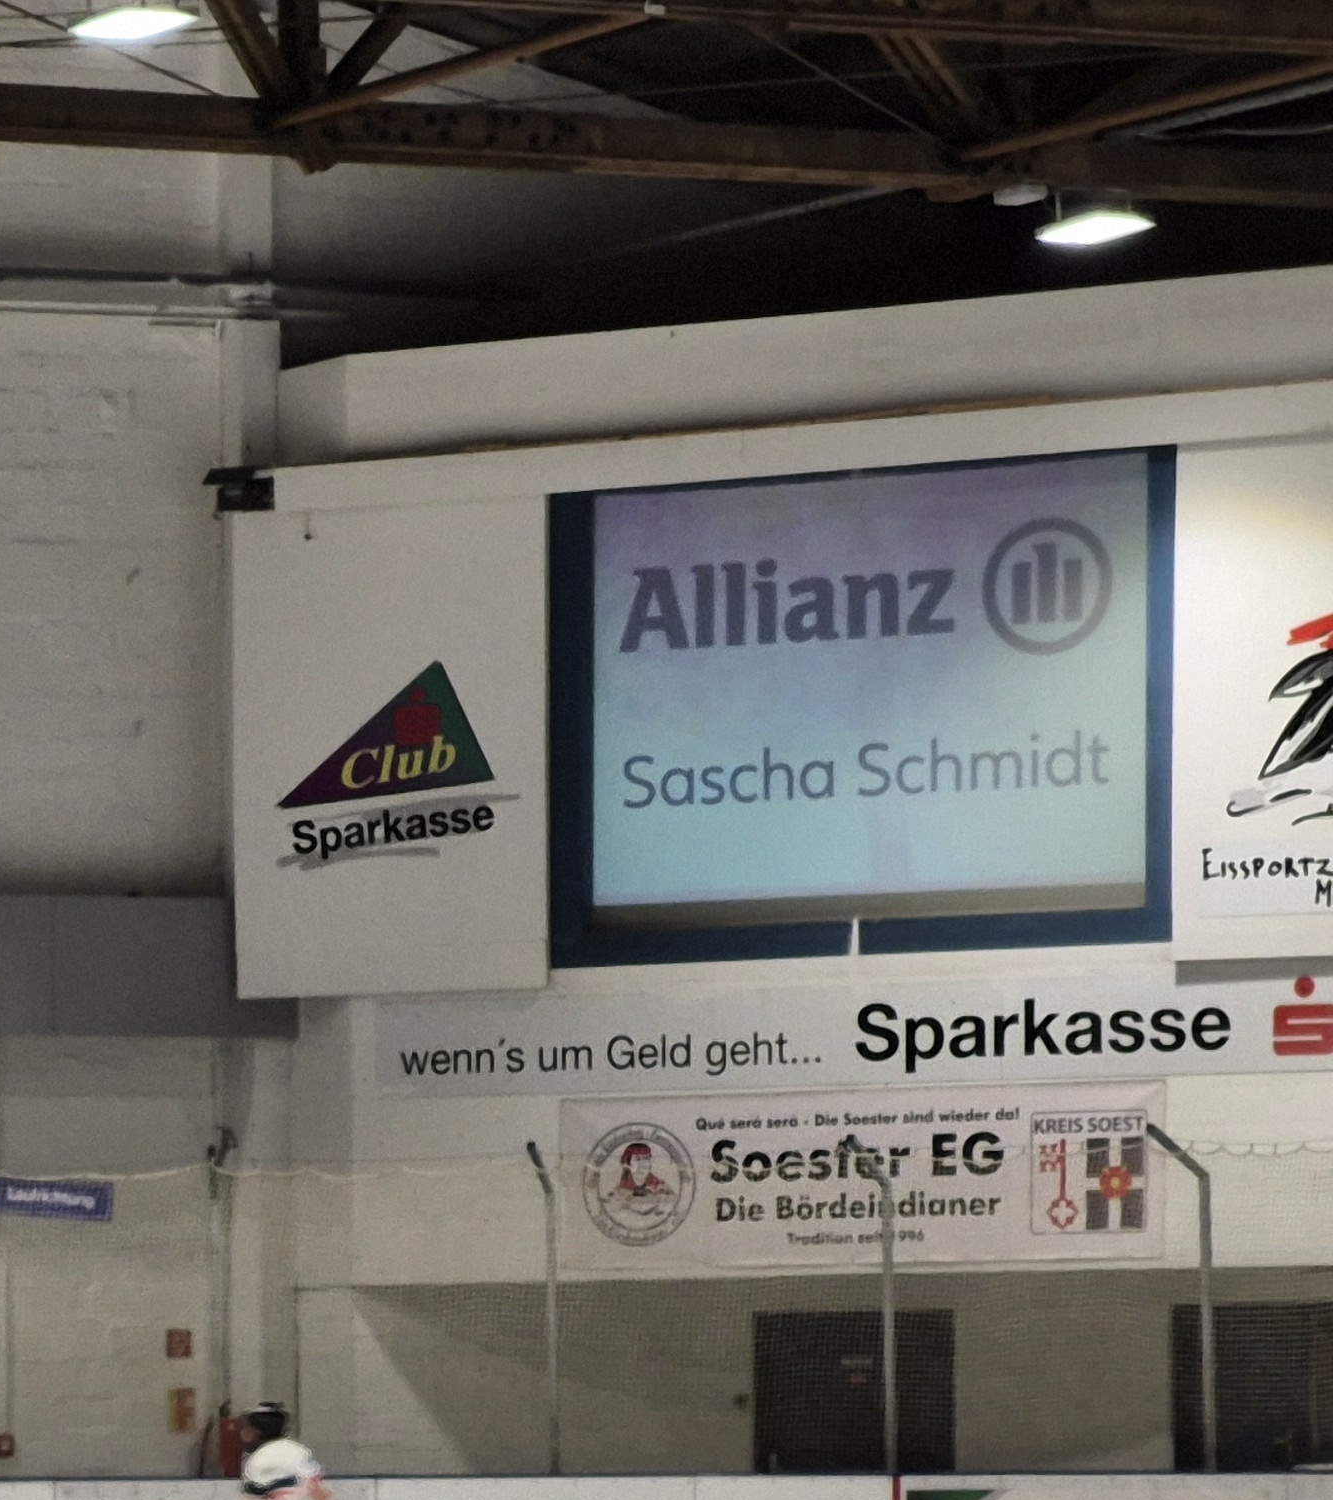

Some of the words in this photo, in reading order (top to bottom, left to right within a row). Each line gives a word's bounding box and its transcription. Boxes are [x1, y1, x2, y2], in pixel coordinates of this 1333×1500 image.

[619, 557, 956, 654] Allianz
[341, 735, 458, 789] Club
[622, 746, 835, 809] Sascha
[858, 729, 1110, 797] Schmidt
[292, 803, 495, 860] Sparkasse
[538, 1042, 593, 1072] um
[606, 1034, 692, 1070] Geld
[705, 1031, 822, 1076] geht...
[855, 998, 1232, 1074] Sparkasse
[814, 1113, 839, 1127] Die
[844, 1112, 898, 1126] Soester
[903, 1111, 933, 1124] sind
[939, 1108, 990, 1122] wieder
[995, 1107, 1020, 1120] da!
[1034, 1118, 1084, 1134] KREIS
[1087, 1116, 1144, 1133] SOEST
[710, 1136, 911, 1183] Soester
[931, 1131, 1005, 1176] EG
[715, 1196, 765, 1222] Die
